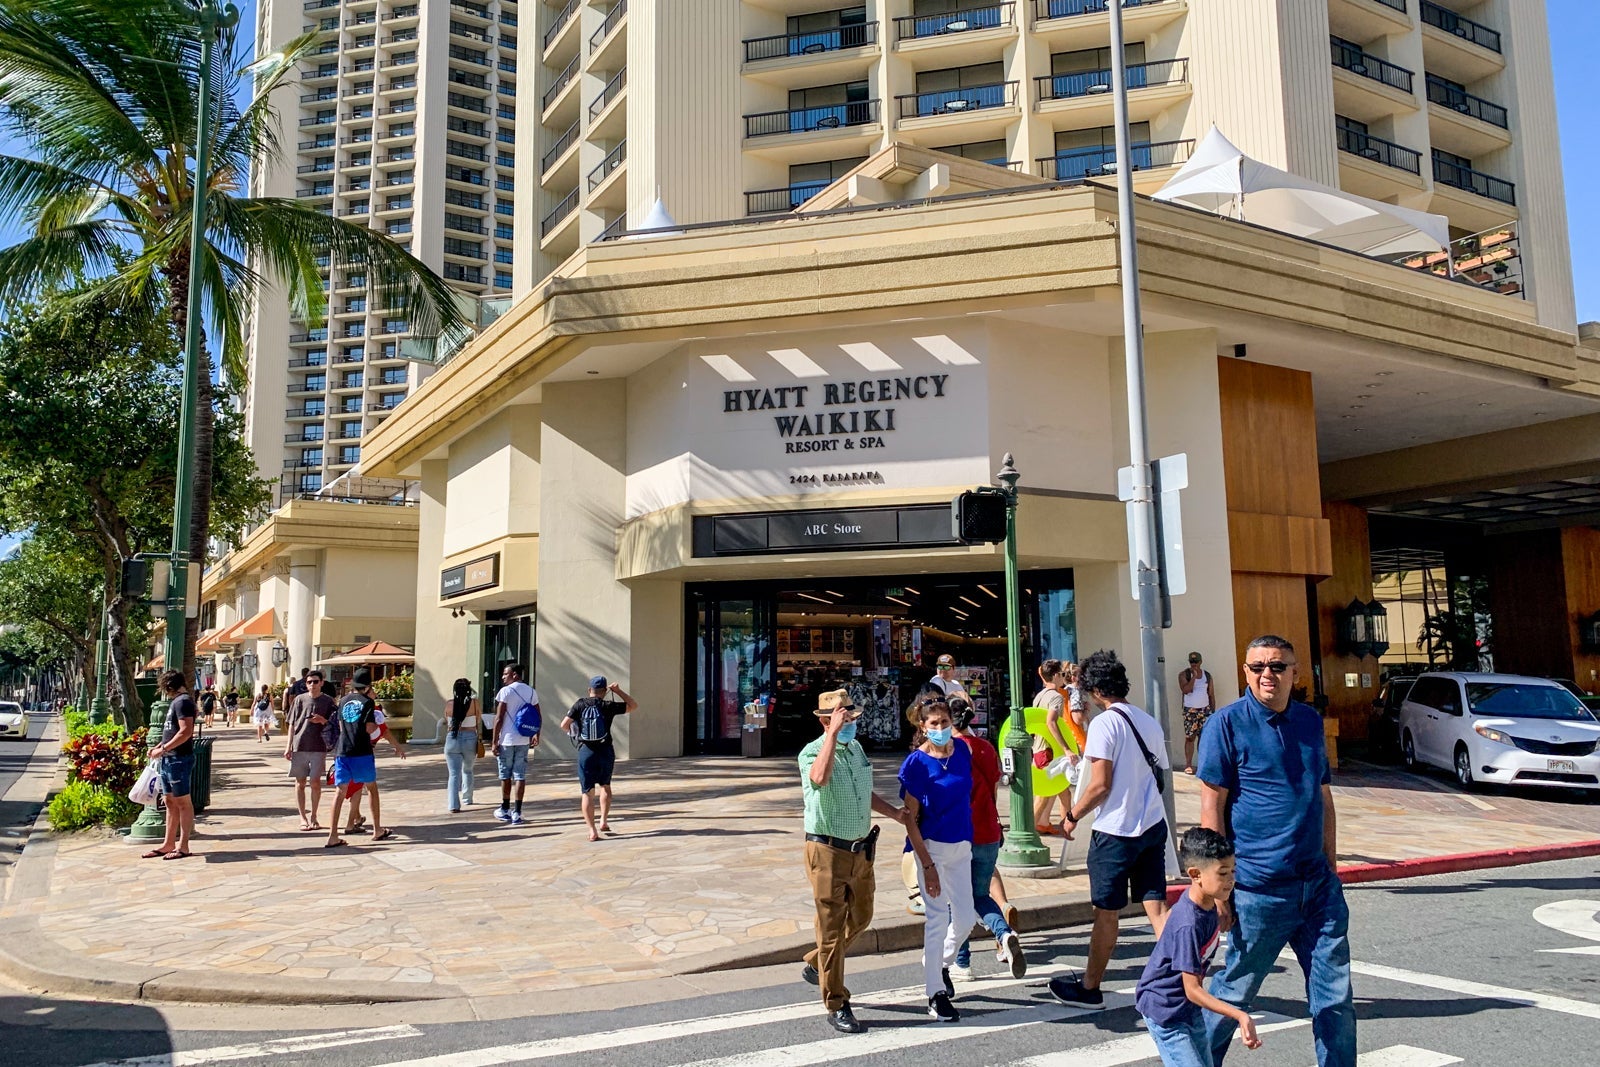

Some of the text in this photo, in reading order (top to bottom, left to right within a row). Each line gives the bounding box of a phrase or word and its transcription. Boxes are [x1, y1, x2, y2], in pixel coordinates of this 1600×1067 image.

[723, 374, 949, 412] HYATT REGENCY
[774, 408, 897, 438] WAIKIKI
[785, 436, 886, 454] RESORT & SPA
[789, 471, 881, 484] 2424 KALAKAUA
[804, 523, 862, 536] ABC Store
